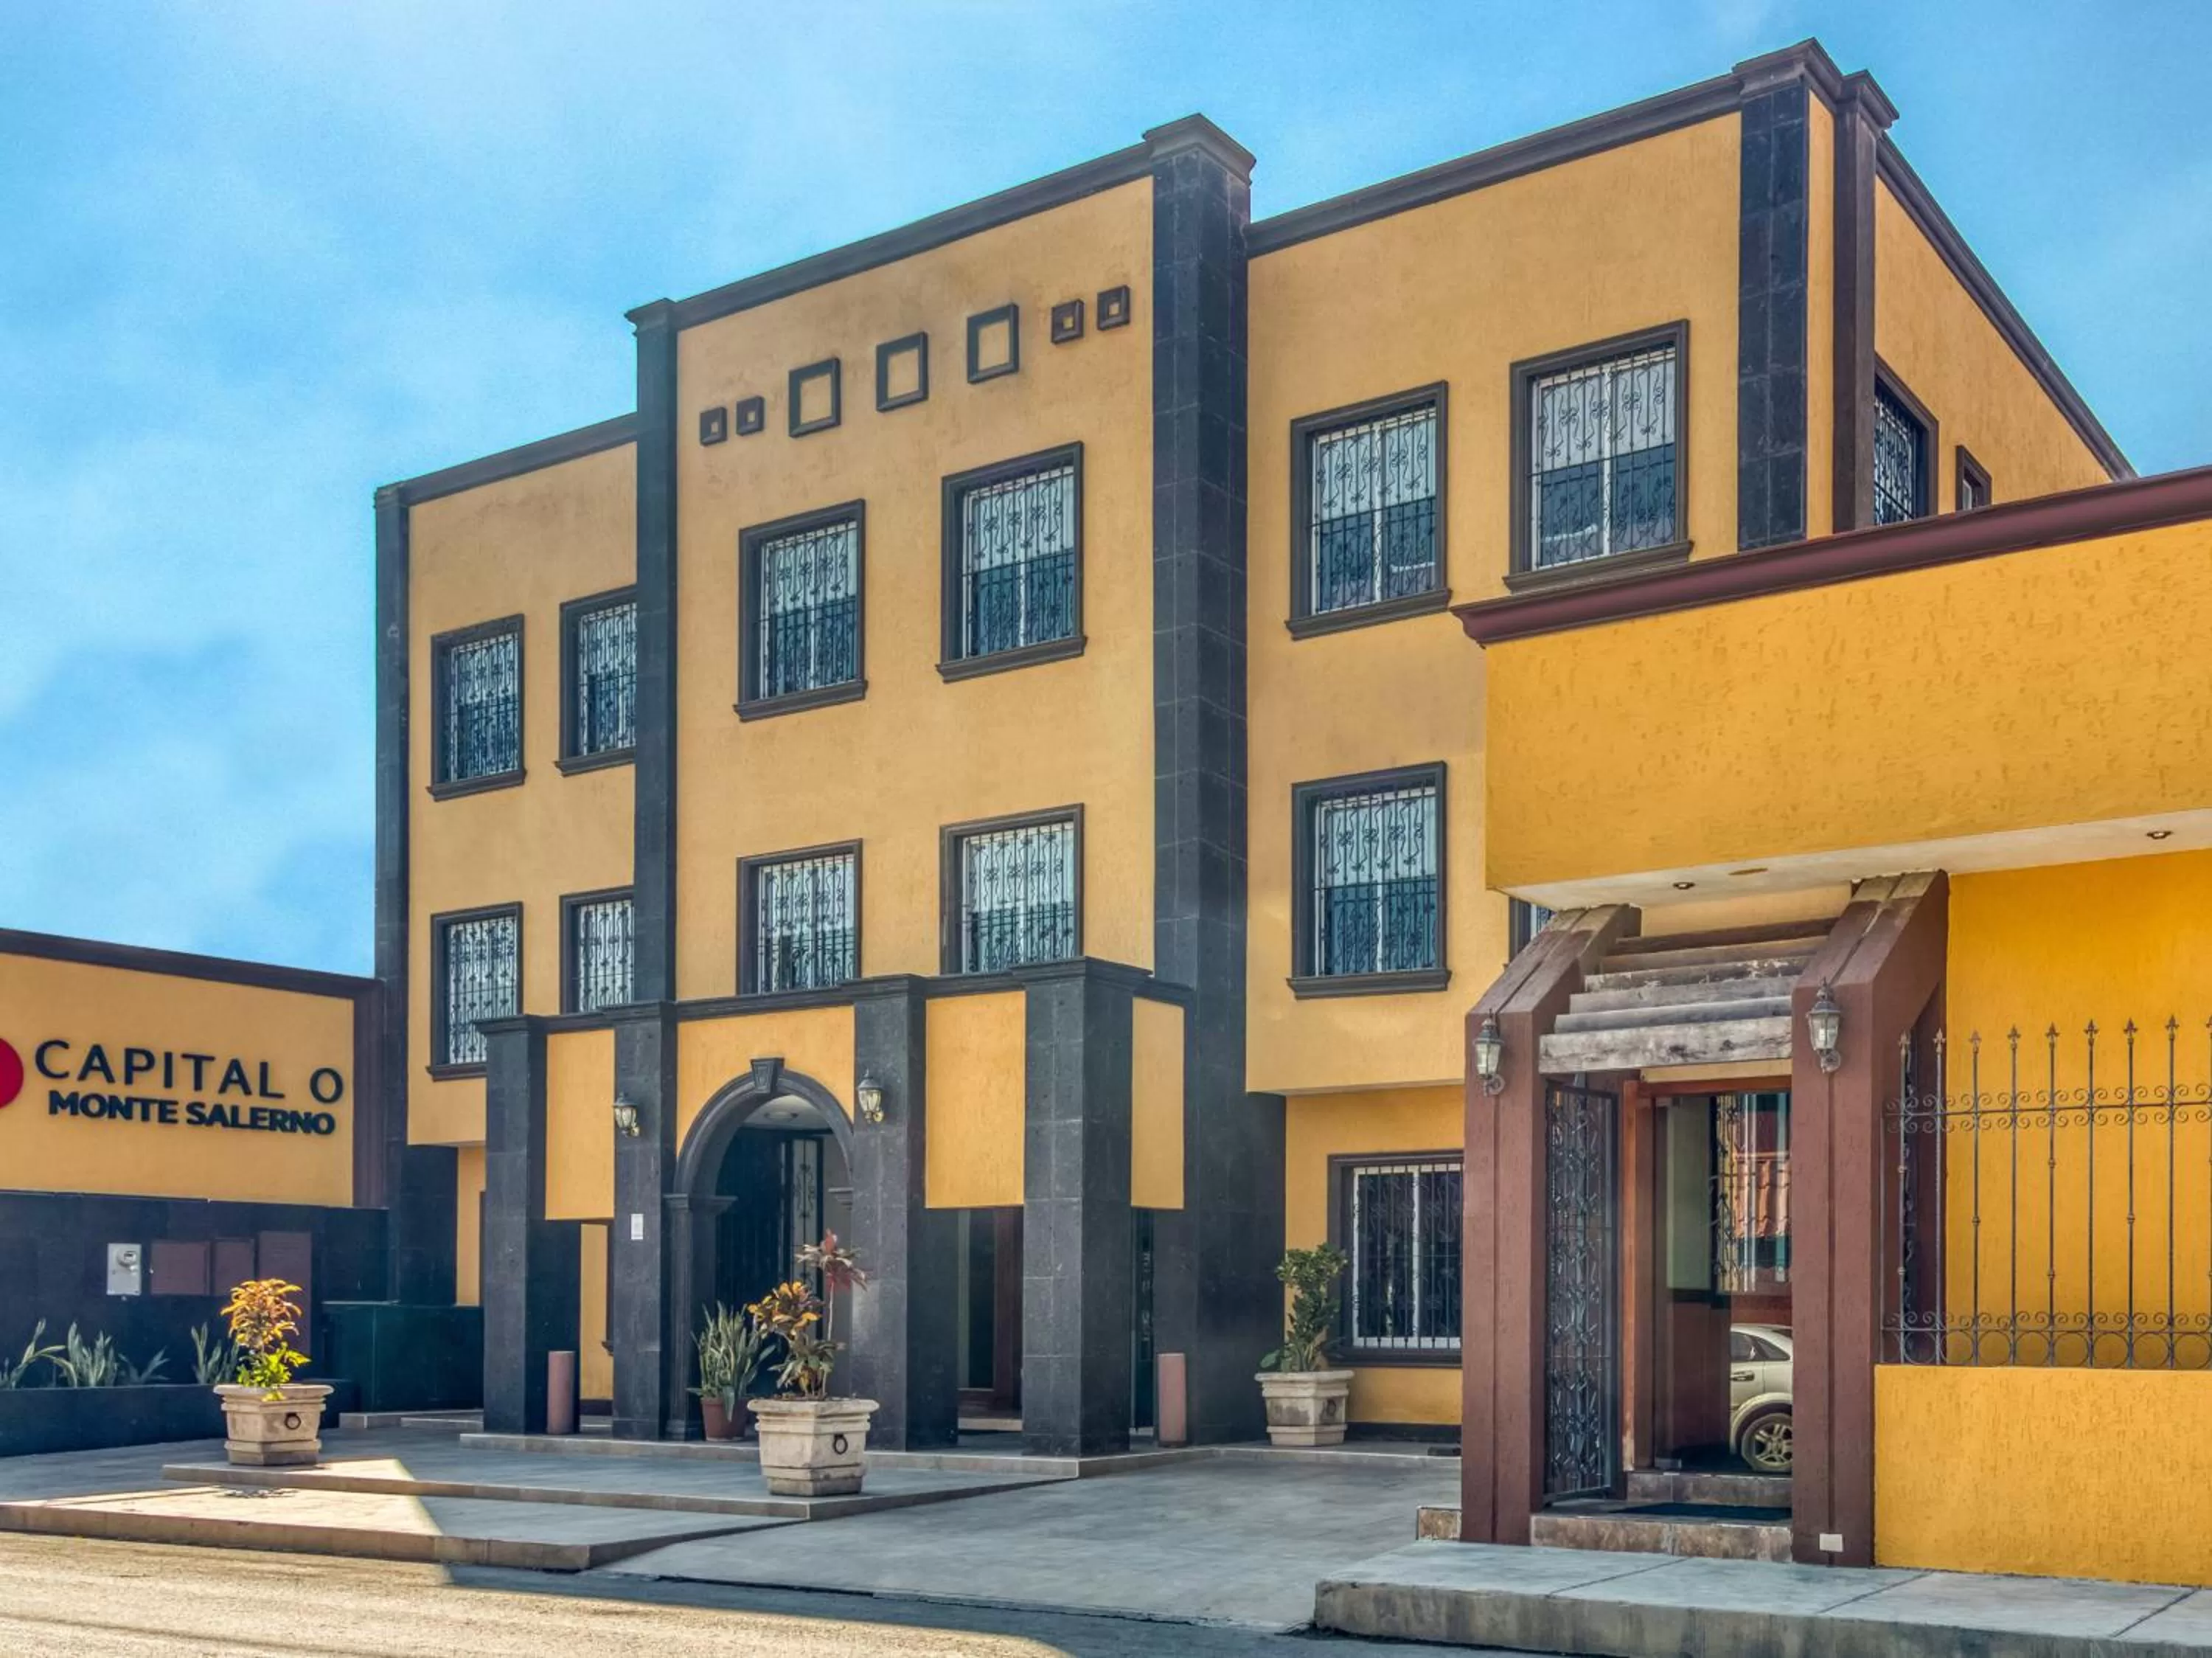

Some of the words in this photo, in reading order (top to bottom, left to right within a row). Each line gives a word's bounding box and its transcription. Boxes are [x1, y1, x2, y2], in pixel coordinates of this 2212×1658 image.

[35, 1038, 285, 1100] CAPITAL
[309, 1067, 344, 1104] O
[48, 1089, 179, 1125] MONTE
[185, 1101, 336, 1136] SALERNO
